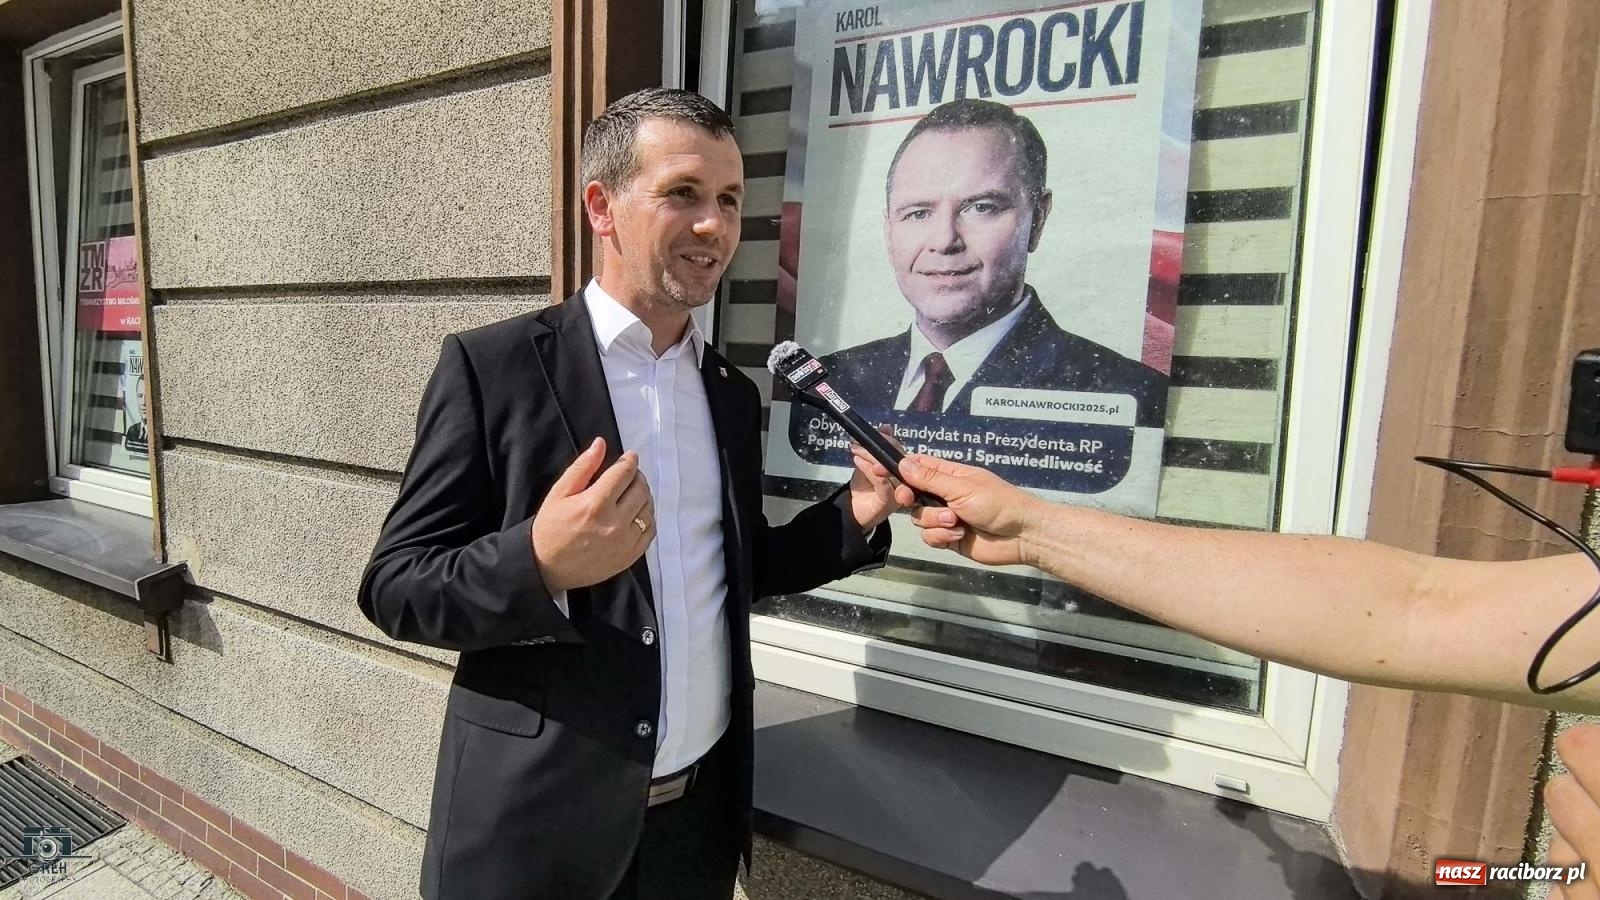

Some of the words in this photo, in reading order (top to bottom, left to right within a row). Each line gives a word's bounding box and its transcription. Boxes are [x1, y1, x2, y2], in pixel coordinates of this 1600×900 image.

[835, 6, 883, 33] KAROL
[829, 0, 1145, 117] NAWROCKI
[127, 316, 141, 325] RACI
[985, 397, 1119, 415] KAROLNAWROCKI2025.pl
[893, 424, 960, 442] kandydat
[963, 432, 981, 444] na
[984, 431, 1075, 452] Prezydenta
[1079, 439, 1103, 454] RP
[808, 434, 851, 450] Popier
[918, 444, 963, 461] Prawo
[966, 447, 972, 461] i
[975, 449, 1104, 474] Sprawiedliwość
